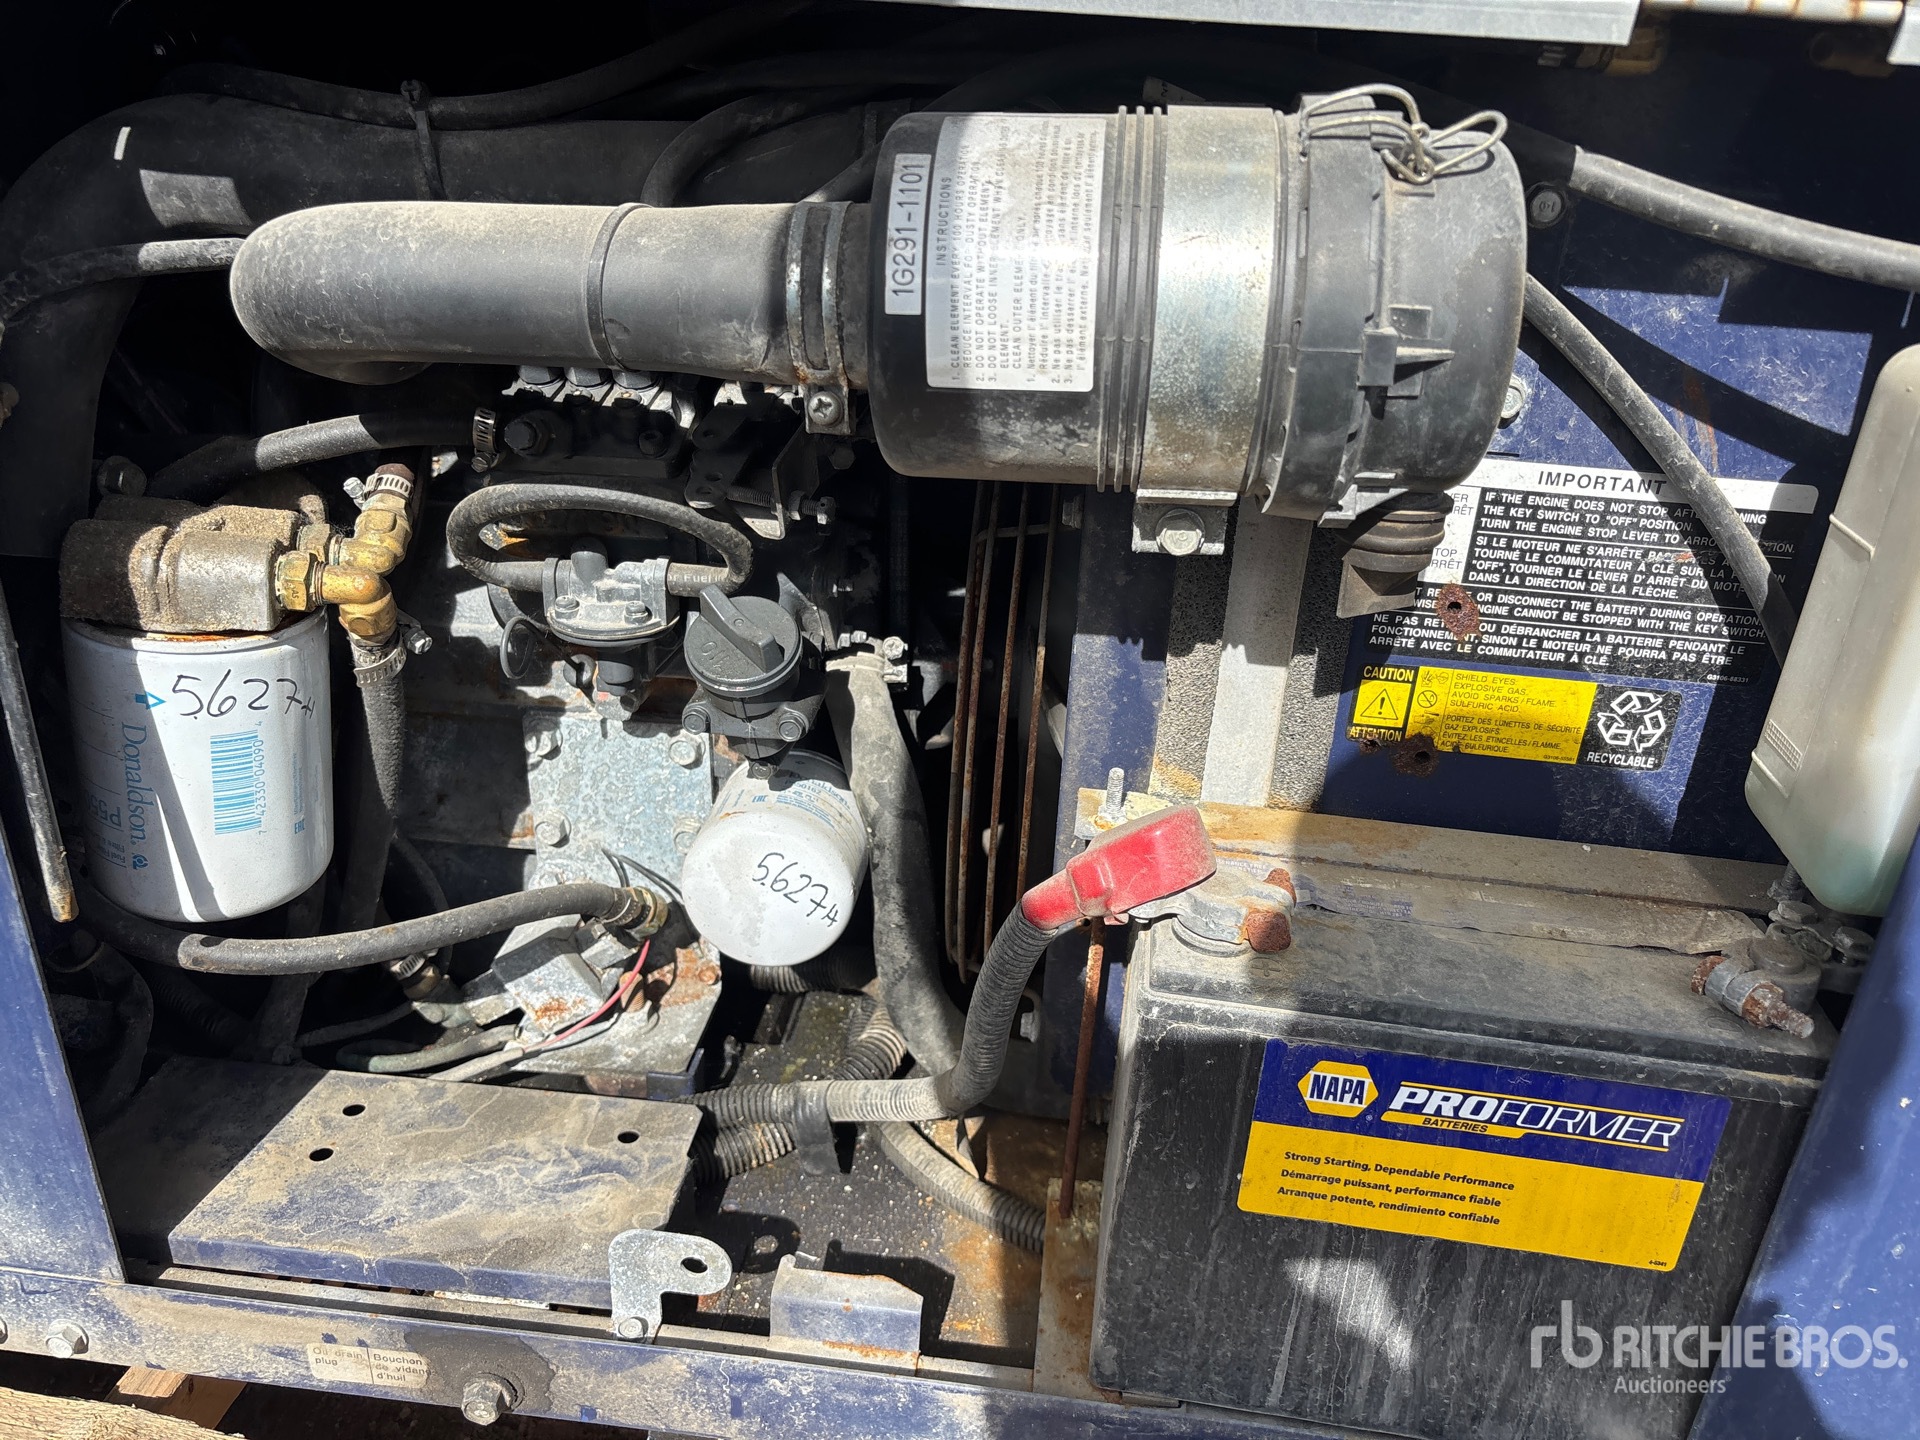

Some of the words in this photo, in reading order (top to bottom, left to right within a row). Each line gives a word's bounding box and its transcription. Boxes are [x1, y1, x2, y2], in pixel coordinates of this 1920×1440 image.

[891, 163, 923, 296] 1G291-1101
[935, 177, 951, 266] INSTRUCTIONS
[948, 284, 960, 330] ELEMENT
[960, 273, 973, 324] INTERVAL
[973, 277, 985, 325] OPERATE
[986, 291, 997, 325] LOOSE
[1011, 298, 1022, 332] OUTER
[948, 336, 960, 367] CLEAN
[960, 329, 973, 367] REDUCE
[974, 330, 984, 349] NOT
[986, 331, 996, 350] NOT
[997, 319, 1010, 368] ELEMENT.
[1010, 337, 1022, 369] CLEAN
[974, 355, 984, 368] DO
[986, 355, 997, 368] DO
[1537, 470, 1666, 494] IMPORTANT
[1485, 491, 1496, 501] IF
[1501, 493, 1522, 504] THE
[1527, 495, 1569, 508] ENGINE
[1573, 498, 1604, 511] DOES
[1609, 502, 1634, 513] NOT
[1638, 505, 1668, 516] STOP
[1480, 517, 1509, 529] TURN
[1515, 520, 1536, 531] THE
[1541, 522, 1582, 536] ENGINE
[1587, 527, 1617, 539] STOP
[1622, 529, 1658, 542] LEVER
[1665, 533, 1679, 544] TO
[1483, 505, 1503, 516] THE
[1509, 507, 1531, 518] KEY
[1536, 509, 1579, 522] SWITCH
[1584, 513, 1599, 524] TO
[1605, 515, 1637, 527] "OFF"
[1639, 518, 1693, 532] POSITION.
[1435, 548, 1457, 558] TOP
[1474, 546, 1519, 560] TOURNÉ
[1524, 552, 1539, 562] LE
[1544, 554, 1631, 570] COMMUTATEUR
[1651, 561, 1674, 574] CLÉ
[1679, 566, 1704, 576] SUR
[1476, 536, 1486, 545] SI
[1492, 537, 1506, 547] LE
[1512, 539, 1559, 551] MOTEUR
[1565, 543, 1581, 553] NE
[1586, 543, 1641, 559] S'ARRÊTE
[683, 573, 712, 582] Fuel
[1468, 572, 1500, 583] DANS
[1505, 575, 1519, 585] LA
[1525, 576, 1585, 590] DIRECTION
[1590, 582, 1605, 592] DE
[1611, 583, 1626, 594] LA
[1632, 584, 1678, 599] FLÈCHE.
[1471, 560, 1506, 573] "OFF",
[1509, 563, 1563, 576] TOURNER
[1567, 568, 1583, 578] LE
[1587, 569, 1627, 582] LEVIER
[1690, 579, 1708, 589] DU
[1476, 592, 1491, 602] OR
[1497, 594, 1565, 609] DISCONNECT
[1570, 600, 1591, 611] THE
[1595, 603, 1644, 616] BATTERY
[1649, 607, 1691, 620] DURING
[1696, 611, 1762, 626] OPERATION.
[1513, 607, 1557, 620] CANNOT
[1562, 612, 1577, 622] BE
[1581, 613, 1631, 627] STOPPED
[1637, 618, 1663, 629] WITH
[1669, 621, 1690, 631] THE
[1694, 623, 1716, 634] KEY
[1721, 625, 1766, 639] SWITCH.
[1373, 613, 1388, 623] NE
[1395, 615, 1418, 626] PAS
[1478, 622, 1496, 633] OU
[1501, 622, 1580, 640] DÉBRANCHER
[1585, 632, 1601, 642] LA
[1606, 634, 1663, 647] BATTERIE
[1668, 639, 1725, 653] PENDANT
[1730, 645, 1745, 655] LE
[1368, 633, 1415, 648] ARRÊTÉ
[1420, 640, 1451, 652] AVEC
[1456, 643, 1472, 653] LE
[1476, 645, 1565, 662] COMMUTATEUR
[1584, 654, 1609, 666] CLÉ.
[1481, 634, 1514, 646] SINON
[1522, 638, 1536, 648] LE
[1542, 640, 1591, 652] MOTEUR
[1596, 644, 1612, 655] NE
[1617, 646, 1665, 660] POURRA
[1672, 651, 1697, 662] PAS
[1701, 651, 1733, 665] ÊTRE
[1363, 666, 1414, 681] CAUTION
[1453, 681, 1503, 693] EXPLOSIVE
[1455, 673, 1487, 683] SHIELD
[1450, 699, 1493, 710] SULFURIC
[1451, 690, 1479, 700] AVOID
[1350, 727, 1401, 741] ATTENTION
[1444, 723, 1458, 731] GAZ
[1445, 714, 1473, 723] PORTEZ
[1477, 717, 1491, 725] DES
[1494, 719, 1530, 729] LUNETTES
[1469, 734, 1482, 742] LES
[253, 739, 264, 777] 04090
[1587, 752, 1655, 768] RECYCLABLE
[255, 780, 266, 817] 42330
[1310, 1072, 1366, 1105] NAPA
[1389, 1084, 1686, 1147] PROFORMER
[1422, 1116, 1489, 1134] BATTERIES
[1284, 1151, 1321, 1165] Strong
[1323, 1156, 1371, 1171] Starting,
[1374, 1163, 1440, 1181] Dependable
[1442, 1172, 1515, 1190] Performance
[1280, 1168, 1341, 1186] Démarrage
[1343, 1177, 1393, 1192] puissant,
[1394, 1184, 1466, 1203] performance
[1468, 1194, 1501, 1207] fiable
[1277, 1186, 1328, 1202] Arranque
[1330, 1193, 1376, 1208] potente,
[1378, 1200, 1446, 1217] rendimiento
[1448, 1209, 1500, 1225] confiable
[315, 1357, 338, 1366] plug
[373, 1353, 423, 1366] Bouchon
